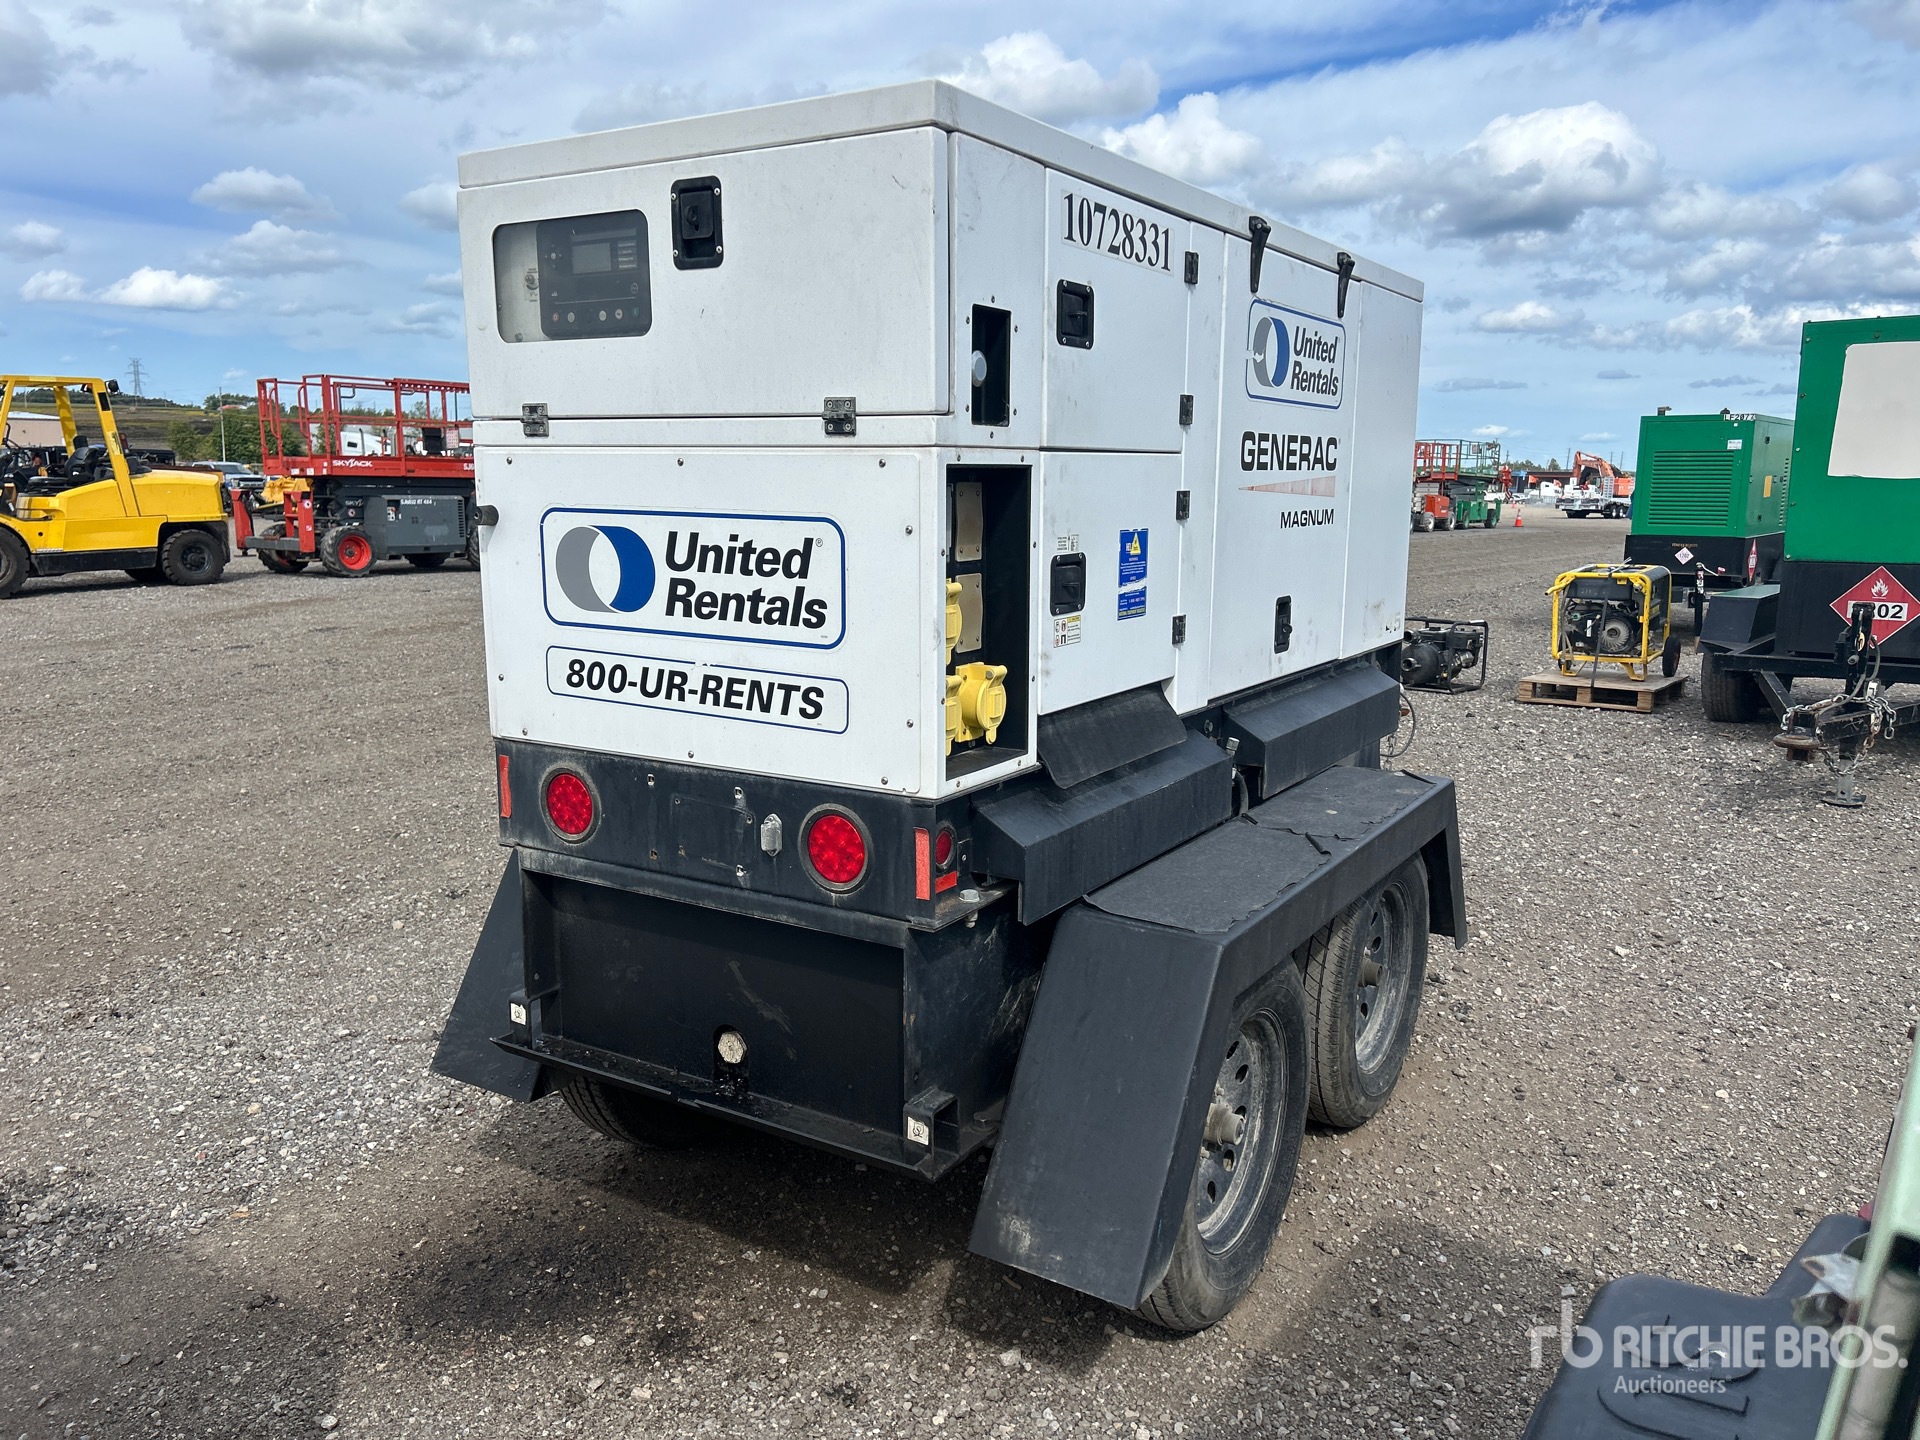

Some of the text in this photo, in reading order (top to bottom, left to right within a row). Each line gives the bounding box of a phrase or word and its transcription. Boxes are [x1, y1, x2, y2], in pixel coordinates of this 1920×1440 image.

[1063, 193, 1171, 271] 10728331
[1294, 326, 1338, 363] United
[1290, 360, 1339, 396] Rentals
[1241, 431, 1337, 471] GENERAC
[1280, 508, 1334, 529] MAGNUM
[665, 531, 814, 579] United
[665, 577, 828, 629] Rentals
[566, 658, 825, 720] 800-UR-RENTS
